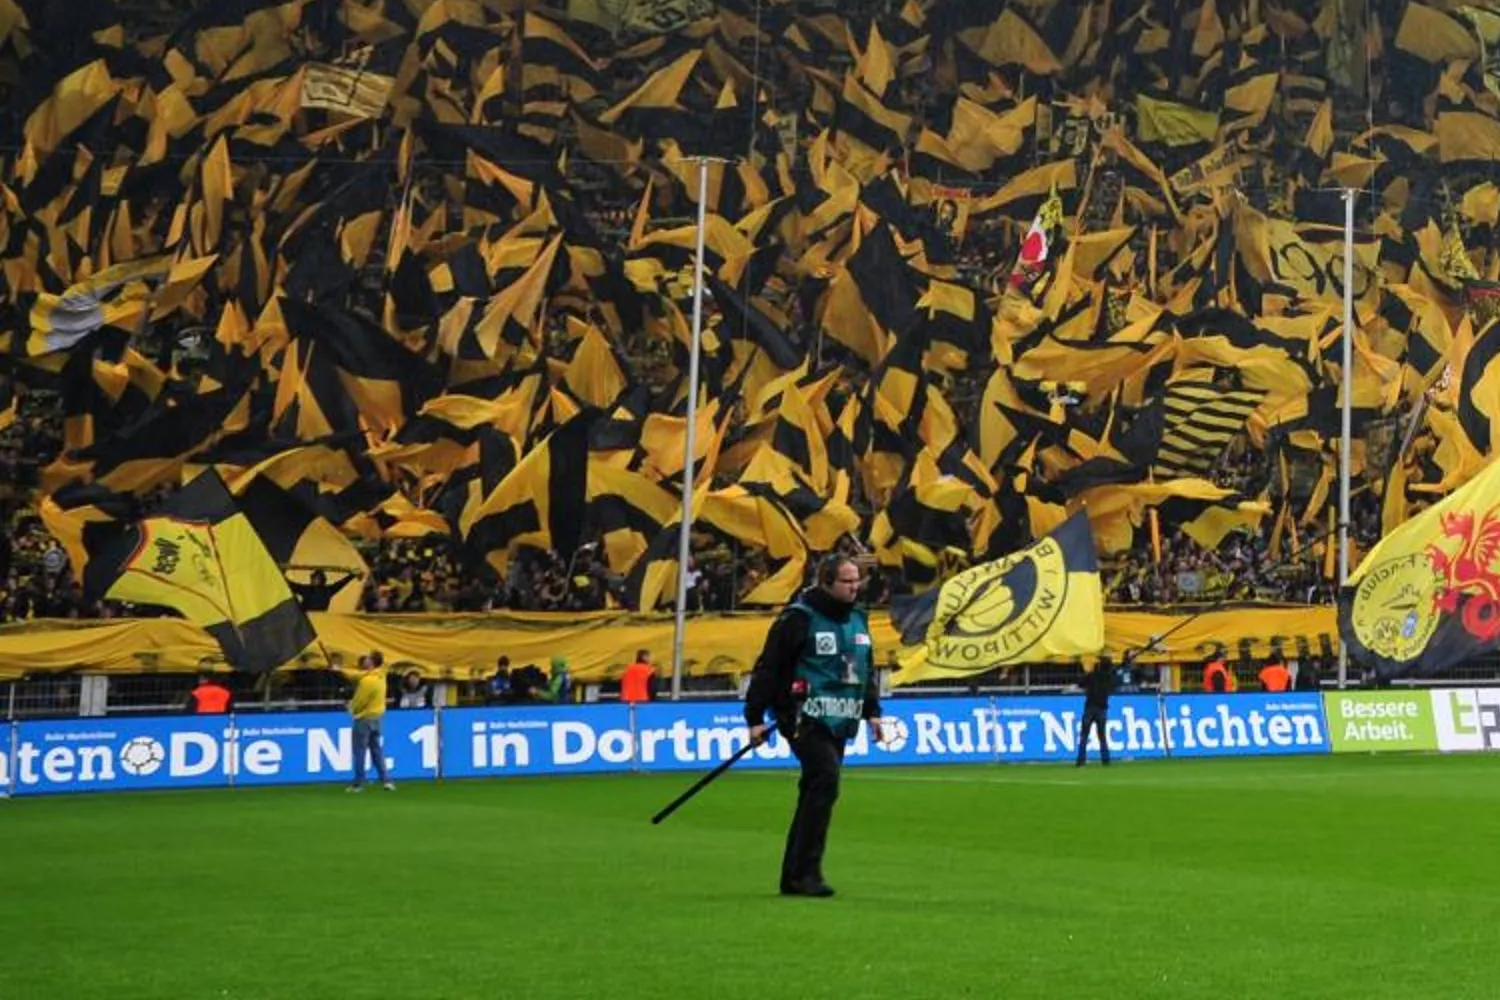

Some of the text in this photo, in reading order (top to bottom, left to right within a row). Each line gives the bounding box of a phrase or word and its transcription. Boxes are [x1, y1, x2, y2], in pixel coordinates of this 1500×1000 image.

[1339, 699, 1418, 718] Bessere
[1343, 720, 1414, 740] Arbeit.
[169, 727, 283, 778] Die
[409, 723, 440, 770] 1
[472, 721, 530, 768] in
[551, 716, 869, 766] Dortmud
[914, 708, 1027, 755] Ruhr
[0, 741, 116, 786] ten
